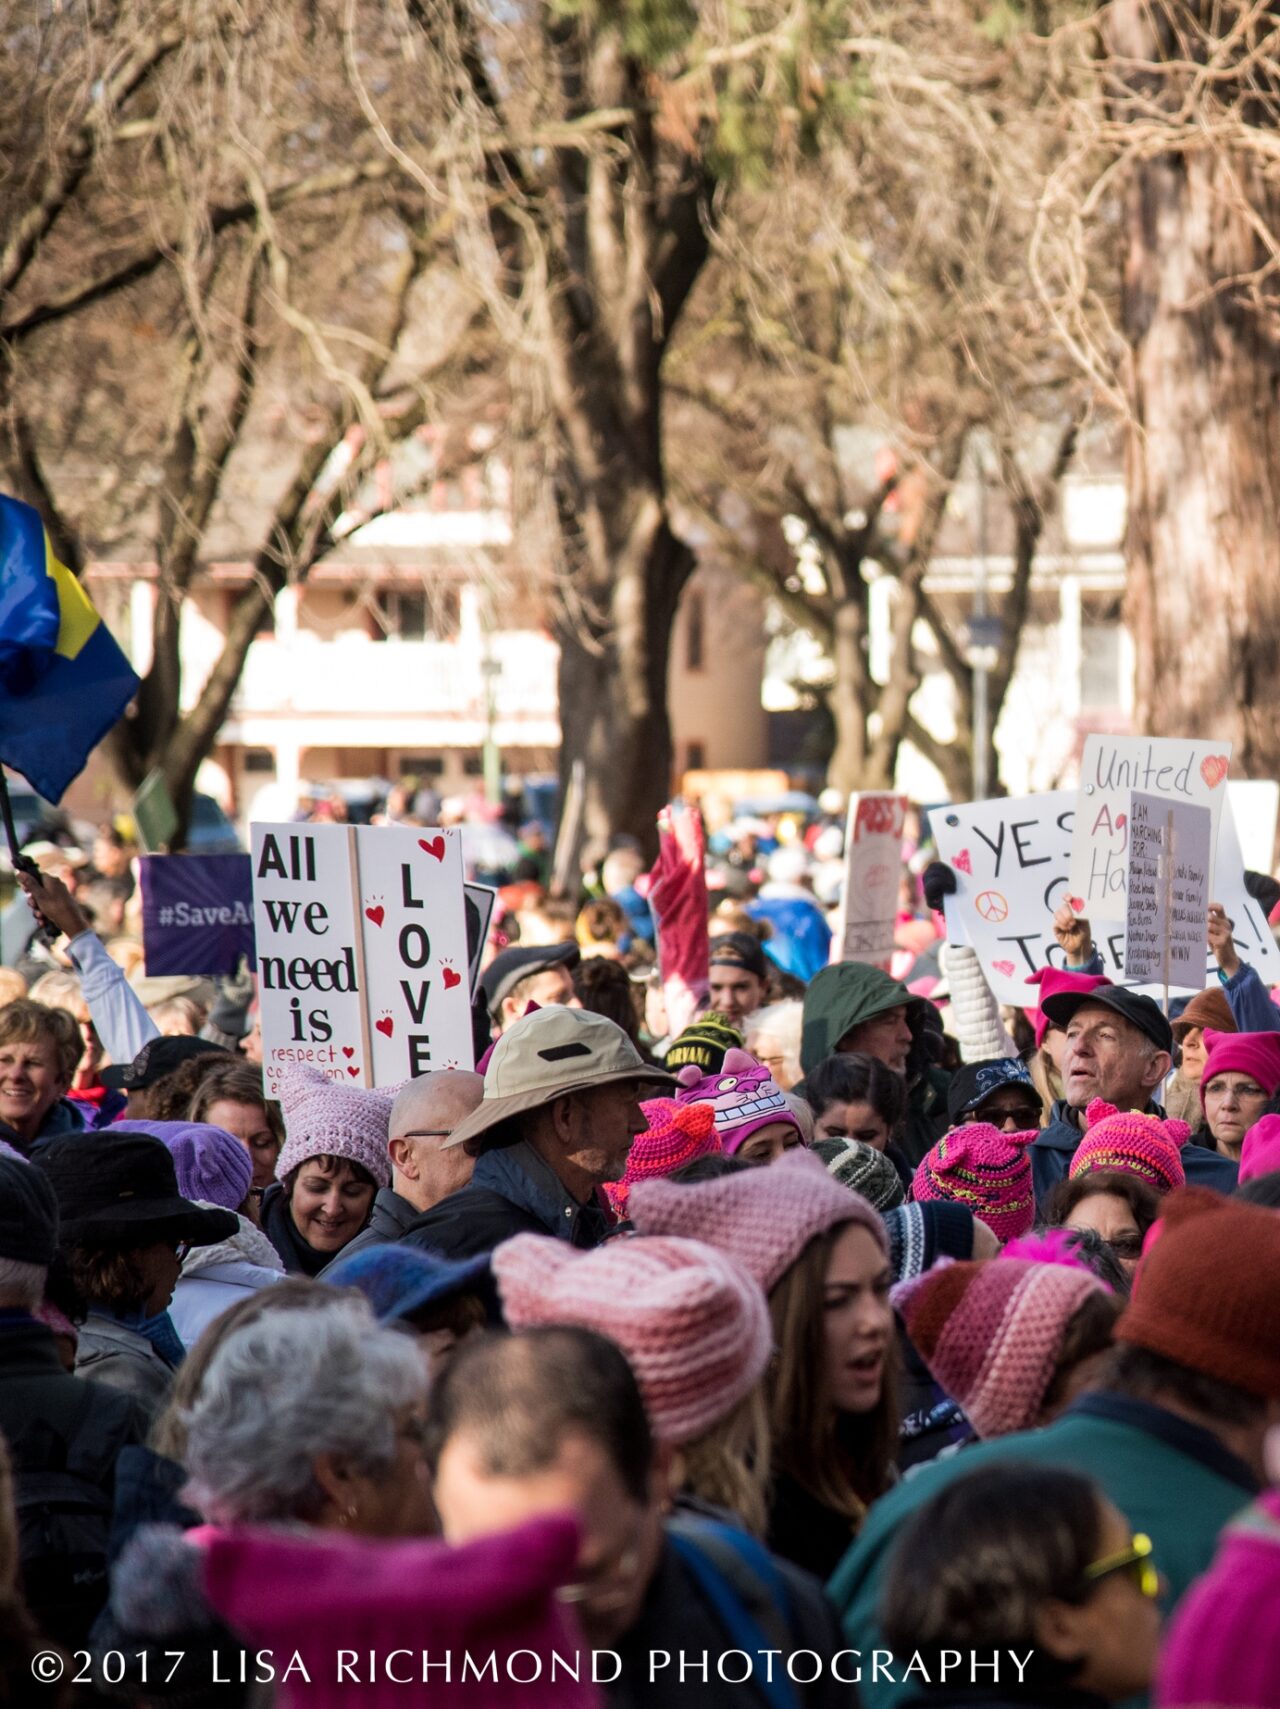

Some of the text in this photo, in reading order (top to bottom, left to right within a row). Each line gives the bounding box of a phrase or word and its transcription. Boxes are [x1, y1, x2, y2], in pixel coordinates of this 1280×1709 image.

[1096, 744, 1194, 796] United
[257, 833, 316, 881] All
[1131, 824, 1162, 845] MARCHING
[262, 899, 330, 935] we
[259, 947, 359, 992] need
[399, 863, 431, 1078] LOVE
[289, 997, 333, 1043] is
[271, 1044, 337, 1063] respect
